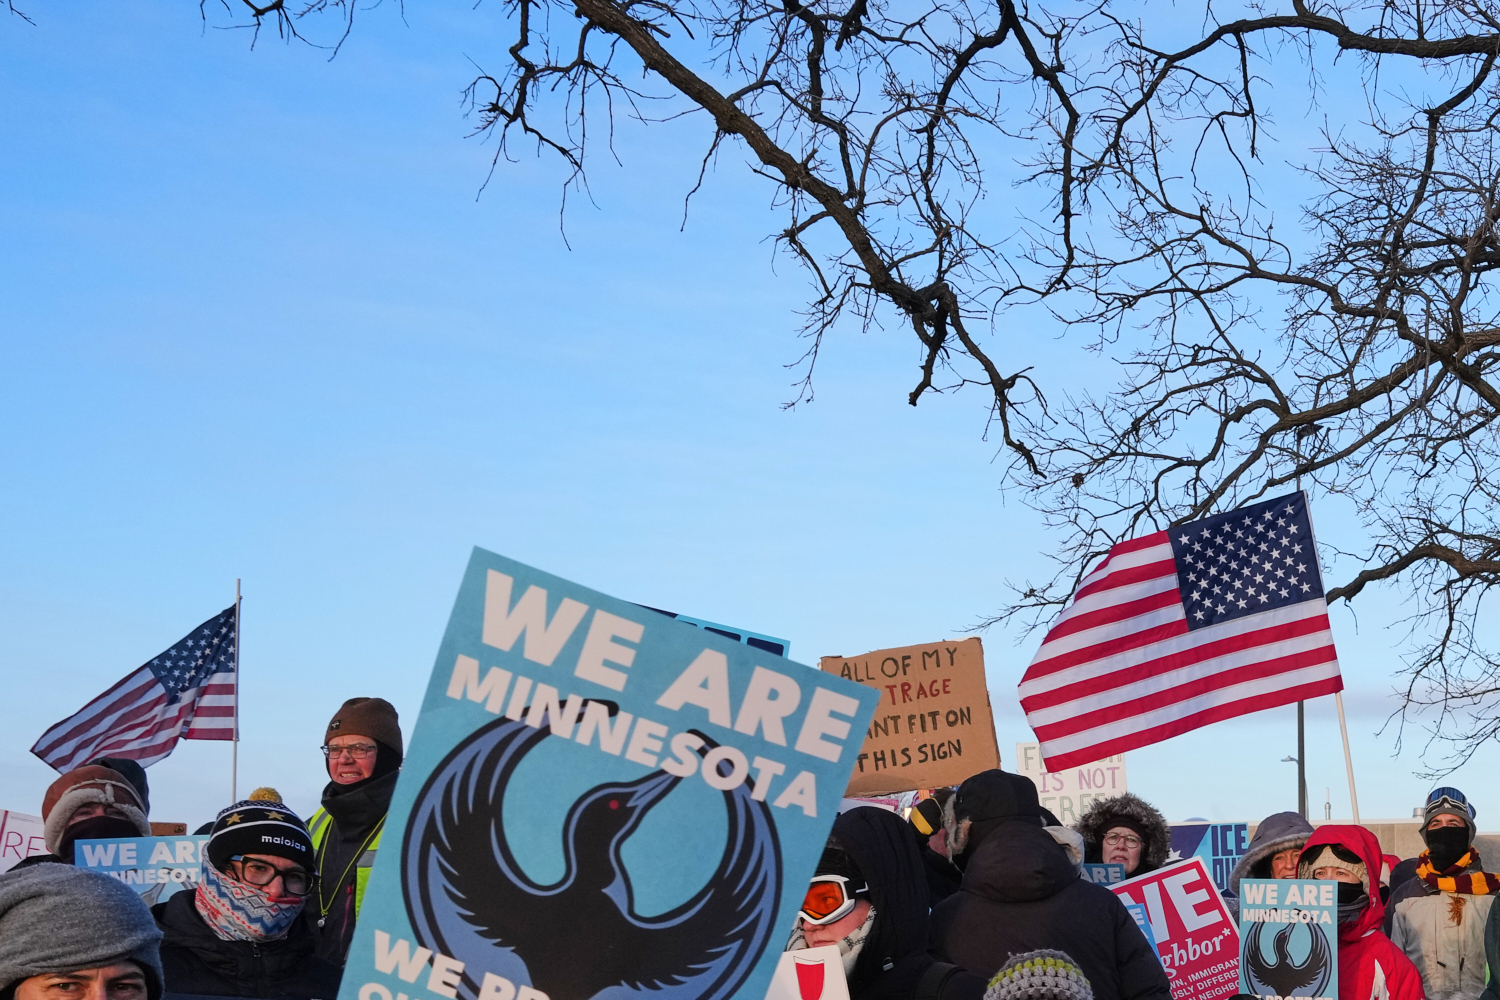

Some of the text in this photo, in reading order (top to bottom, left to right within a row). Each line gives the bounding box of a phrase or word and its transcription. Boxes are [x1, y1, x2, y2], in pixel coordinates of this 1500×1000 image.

[482, 568, 860, 763] WE ARE
[840, 647, 958, 683] ALL OF MY
[885, 679, 952, 705] TRAGE
[908, 711, 940, 734] FIT
[945, 706, 971, 727] ON
[445, 653, 818, 818] MINNESOTA
[857, 739, 962, 772] THIS SIGN
[1040, 767, 1120, 793] IS NOT
[82, 843, 137, 867] WE
[1211, 824, 1248, 856] ICE
[1243, 883, 1333, 906] WE ARE
[1243, 908, 1332, 924] MINNESOTA
[374, 930, 465, 999] WE
